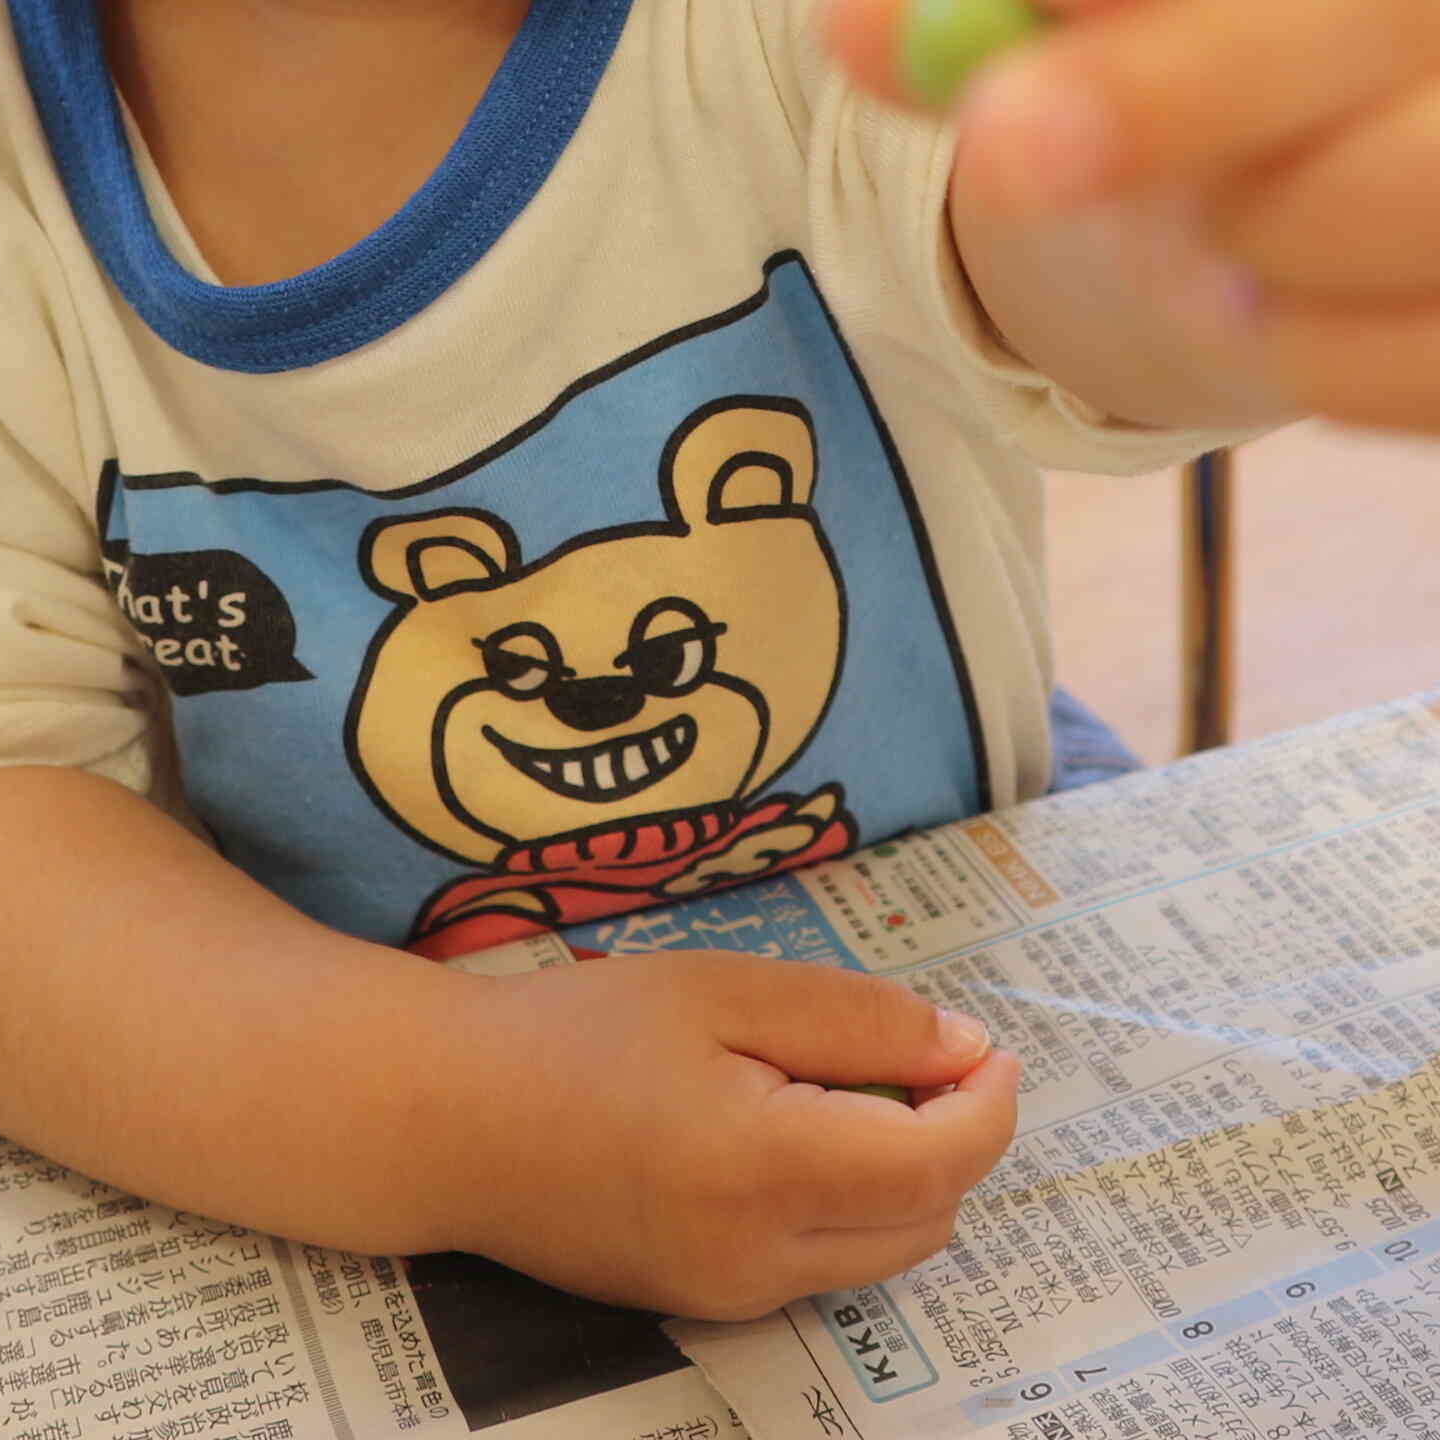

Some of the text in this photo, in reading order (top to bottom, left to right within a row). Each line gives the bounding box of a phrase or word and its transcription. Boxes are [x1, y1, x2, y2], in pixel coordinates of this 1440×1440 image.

[1381, 1231, 1421, 1269] 10
[1283, 1274, 1317, 1304] 9
[850, 1280, 909, 1356] 鹿児島放
[1180, 1314, 1216, 1346] 8
[832, 1299, 899, 1387] KKB
[1073, 1356, 1108, 1385] 7
[1018, 1376, 1054, 1406] 6
